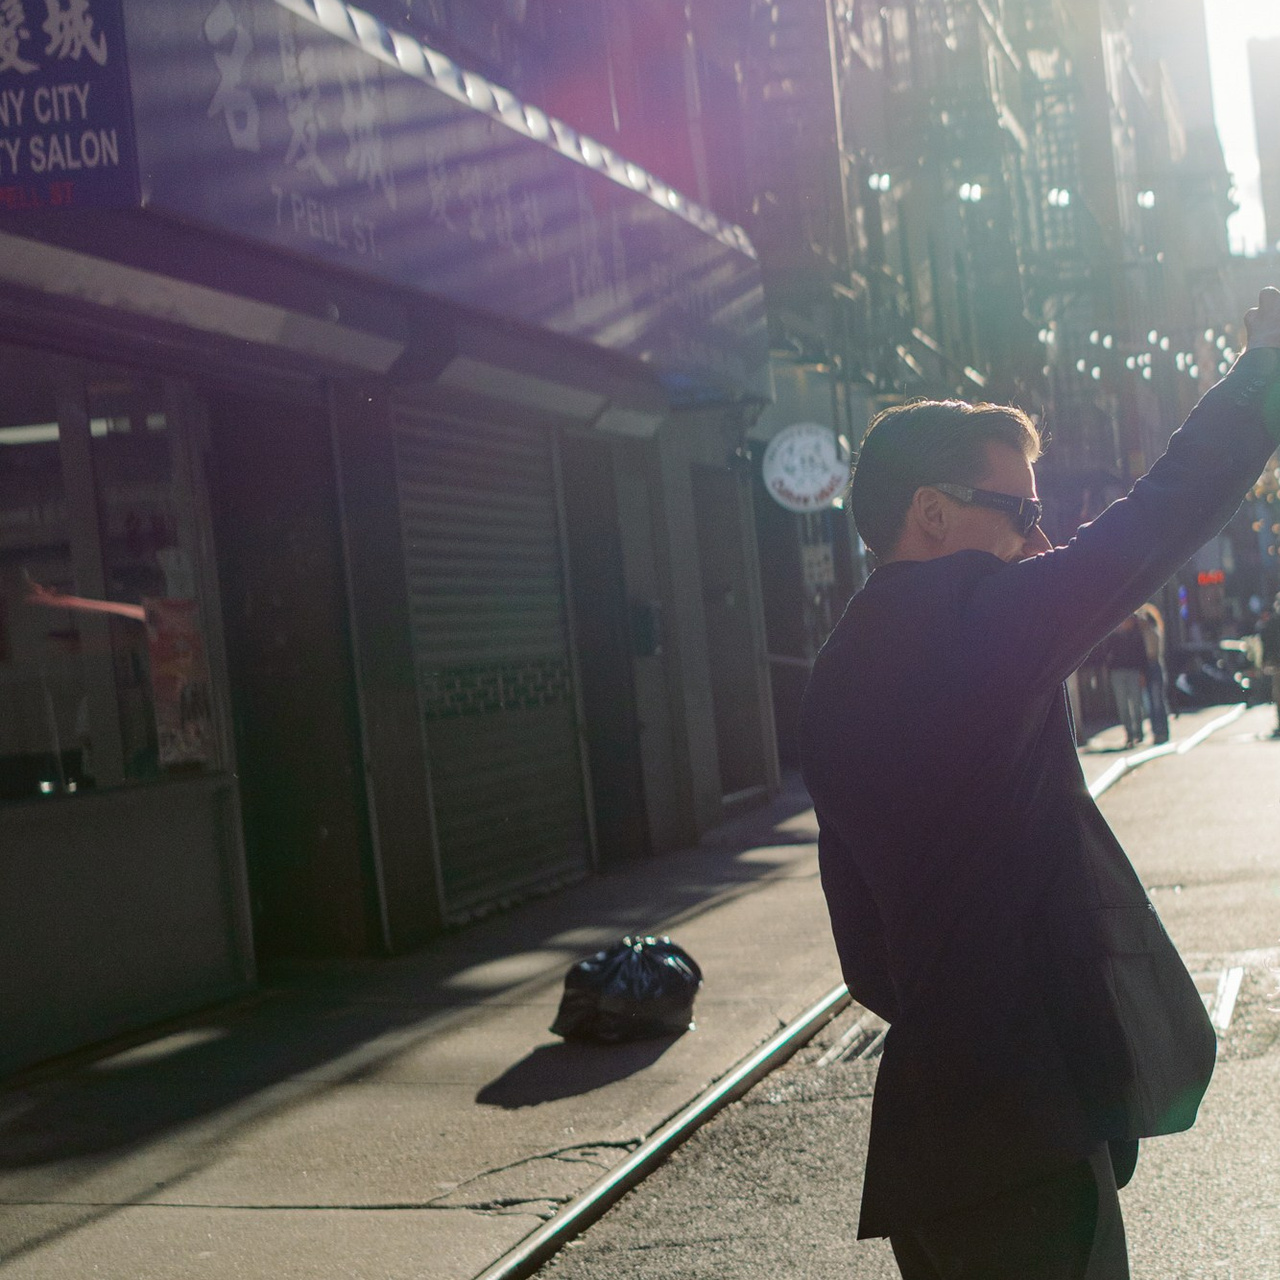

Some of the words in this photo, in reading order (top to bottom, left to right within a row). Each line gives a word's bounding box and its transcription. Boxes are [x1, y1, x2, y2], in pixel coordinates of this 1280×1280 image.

[33, 81, 90, 125] CITY
[29, 128, 119, 174] SALON
[290, 192, 348, 249] PELL
